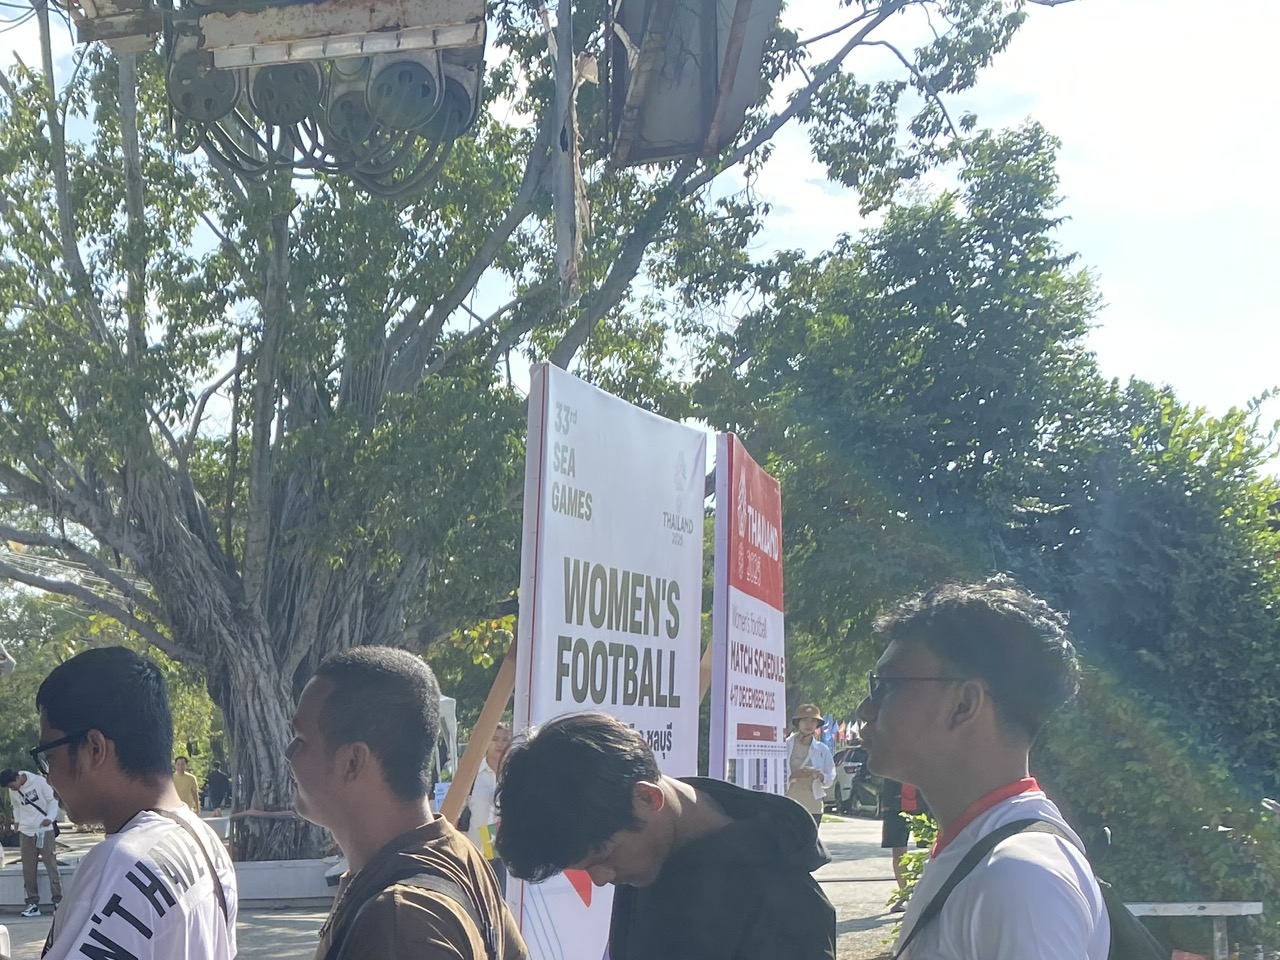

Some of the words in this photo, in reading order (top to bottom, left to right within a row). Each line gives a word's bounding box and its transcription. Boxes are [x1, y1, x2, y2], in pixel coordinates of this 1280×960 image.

[552, 441, 576, 478] SEA
[551, 481, 593, 522] GAMES
[662, 511, 694, 535] THAILAND
[747, 504, 779, 562] THAILAND
[563, 556, 681, 640] WOMEN'S
[555, 635, 681, 708] FOOTBALL
[730, 640, 753, 676] MATCH
[753, 647, 785, 683] SCHEDULE
[738, 685, 765, 710] DECEMBER
